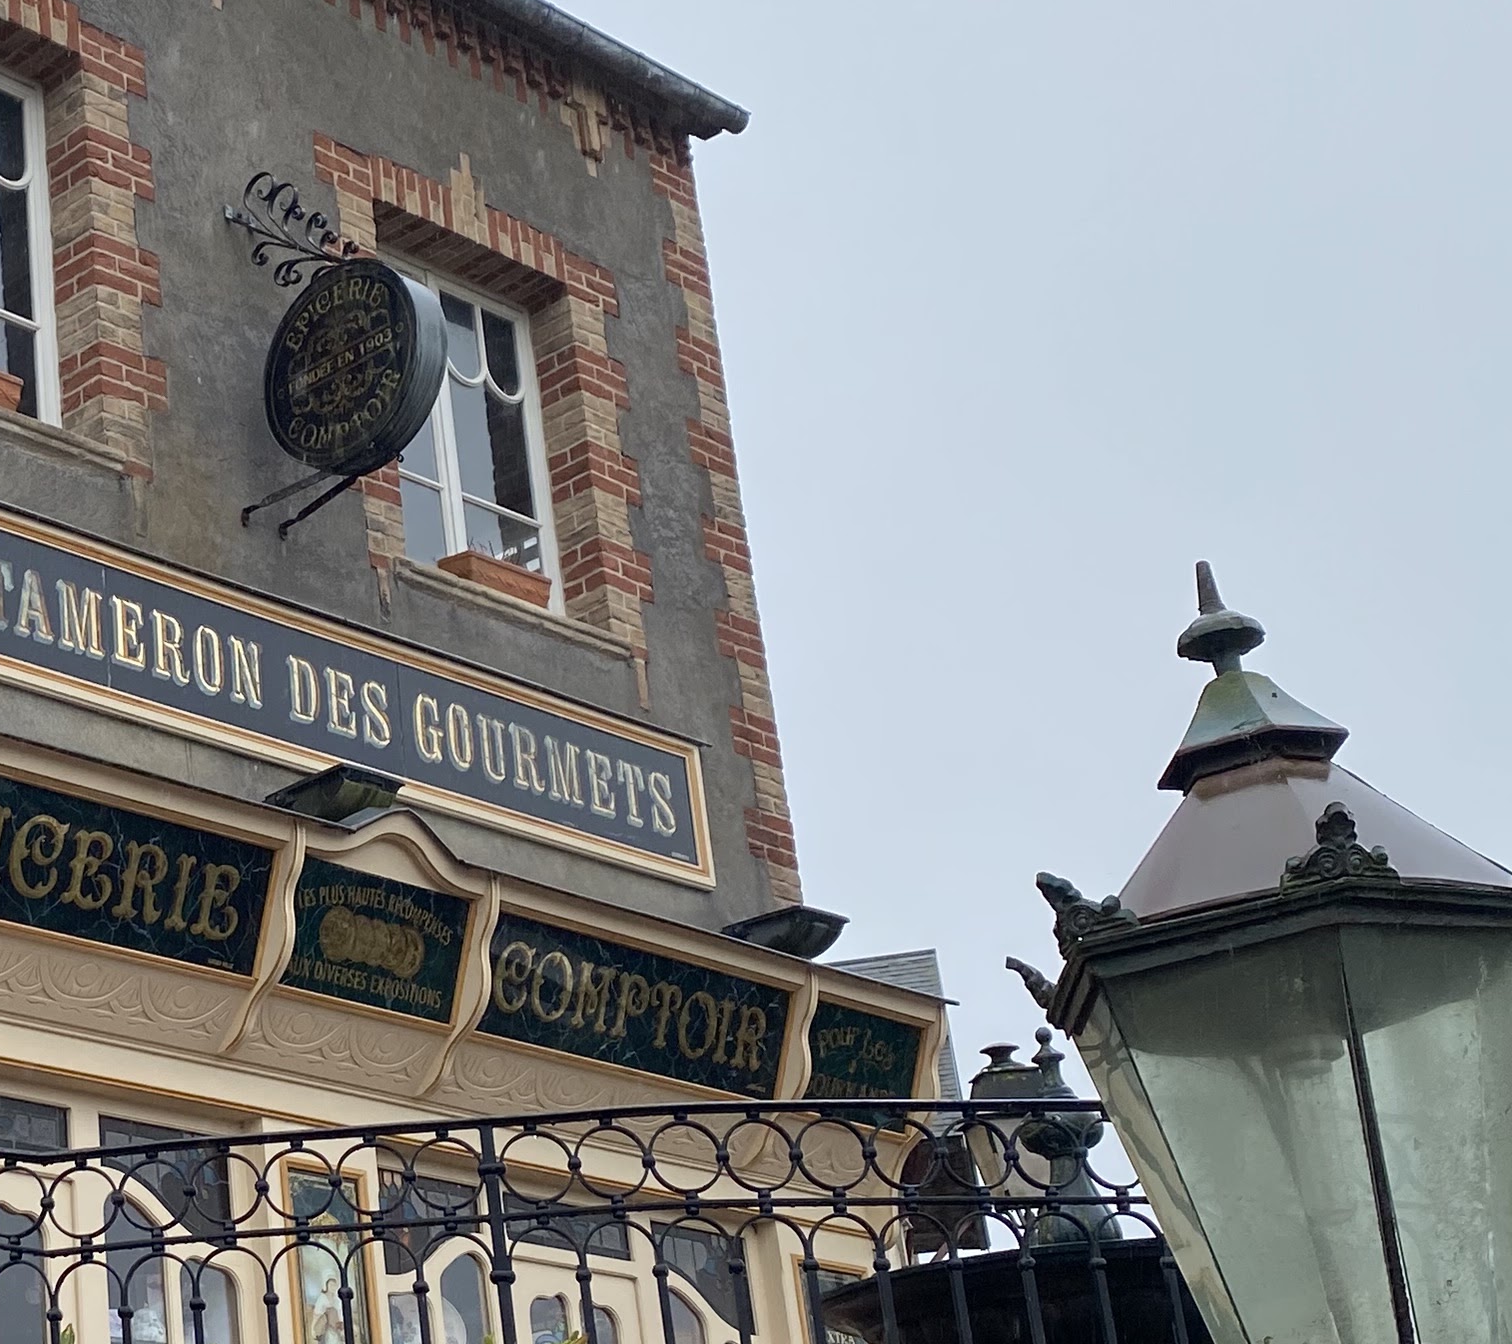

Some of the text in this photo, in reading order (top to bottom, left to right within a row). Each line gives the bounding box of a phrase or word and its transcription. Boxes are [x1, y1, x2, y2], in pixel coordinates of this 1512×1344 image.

[286, 278, 385, 352] EPICERIE
[337, 349, 355, 371] EN
[359, 328, 393, 357] 1903
[288, 653, 392, 749] DES
[413, 692, 677, 838] GOURMETS
[319, 884, 345, 906] PLUS
[313, 960, 368, 991] DIVERSES
[493, 940, 767, 1073] COMPTOIR
